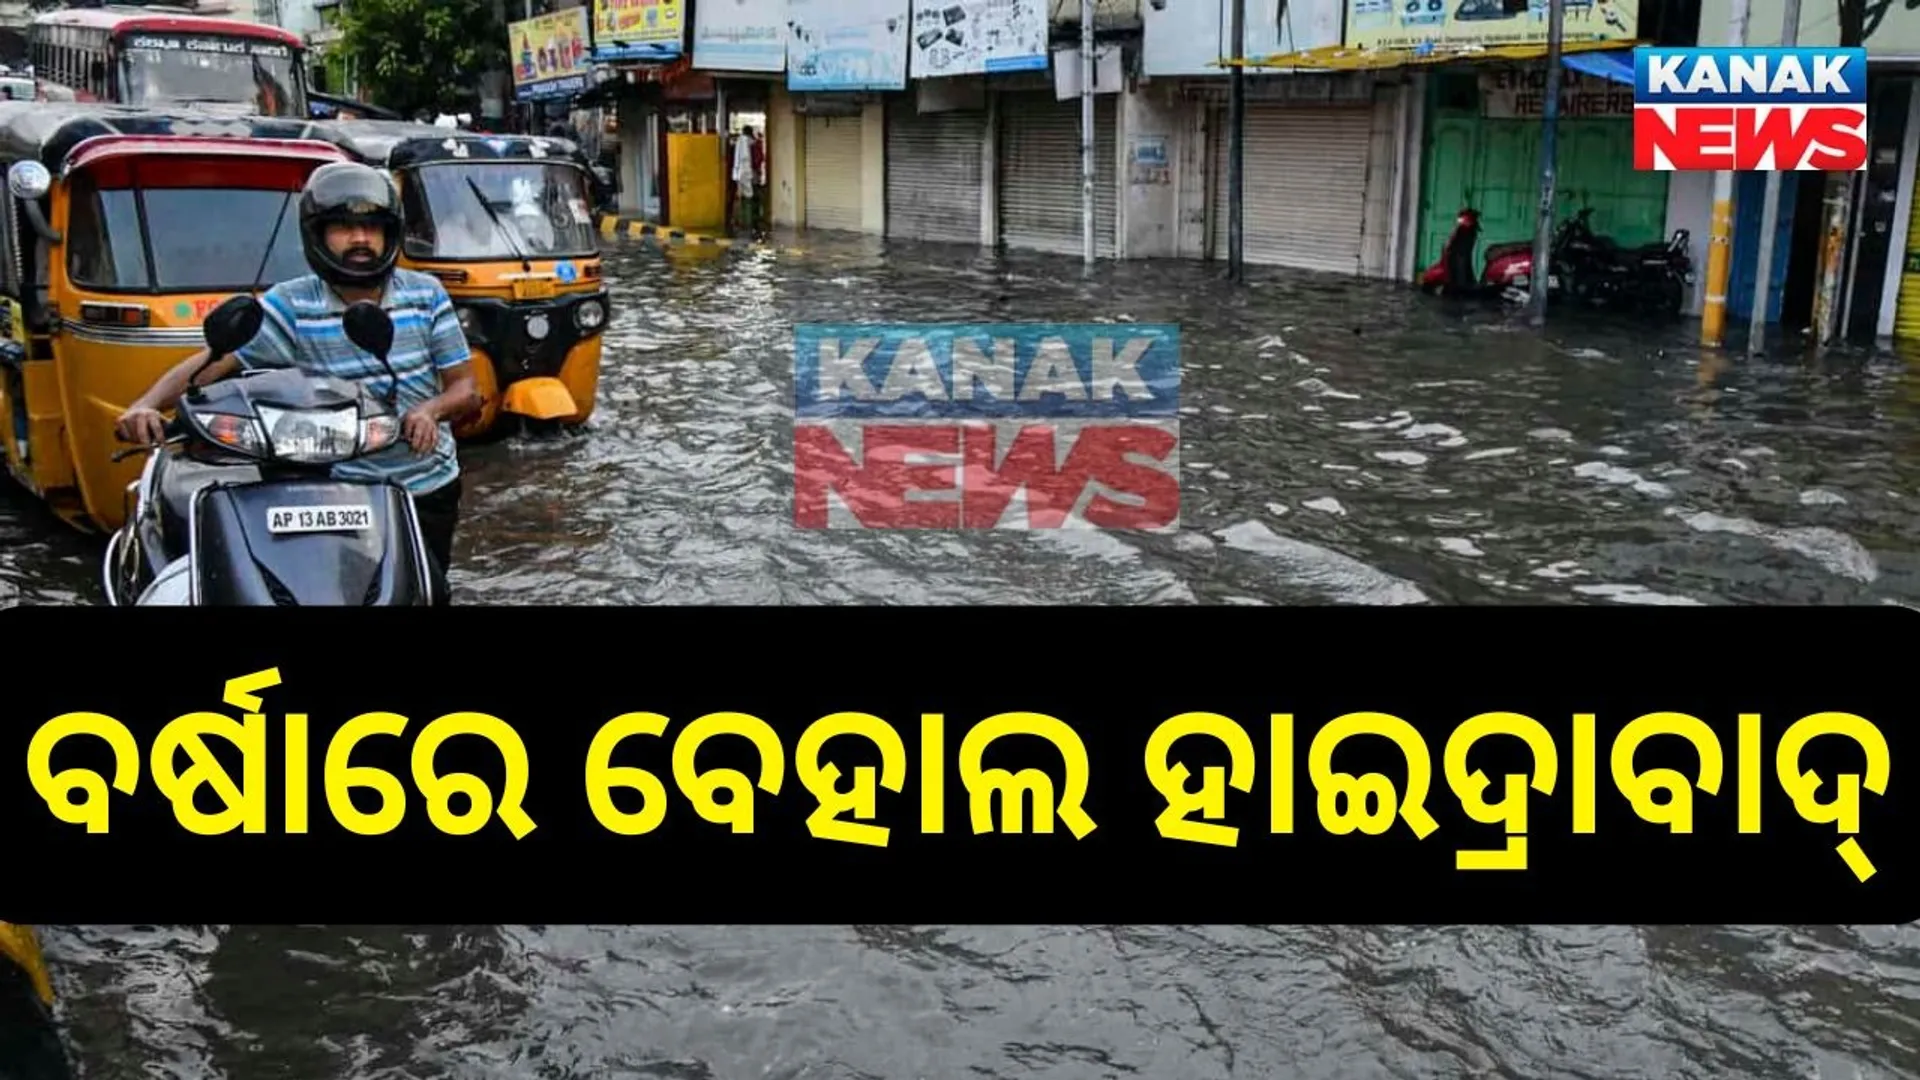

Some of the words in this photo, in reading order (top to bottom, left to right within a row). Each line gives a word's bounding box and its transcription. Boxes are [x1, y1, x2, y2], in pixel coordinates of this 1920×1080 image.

[272, 512, 293, 529] AP
[299, 511, 314, 527] 13
[316, 510, 337, 527] AB
[338, 509, 369, 526] 3021
